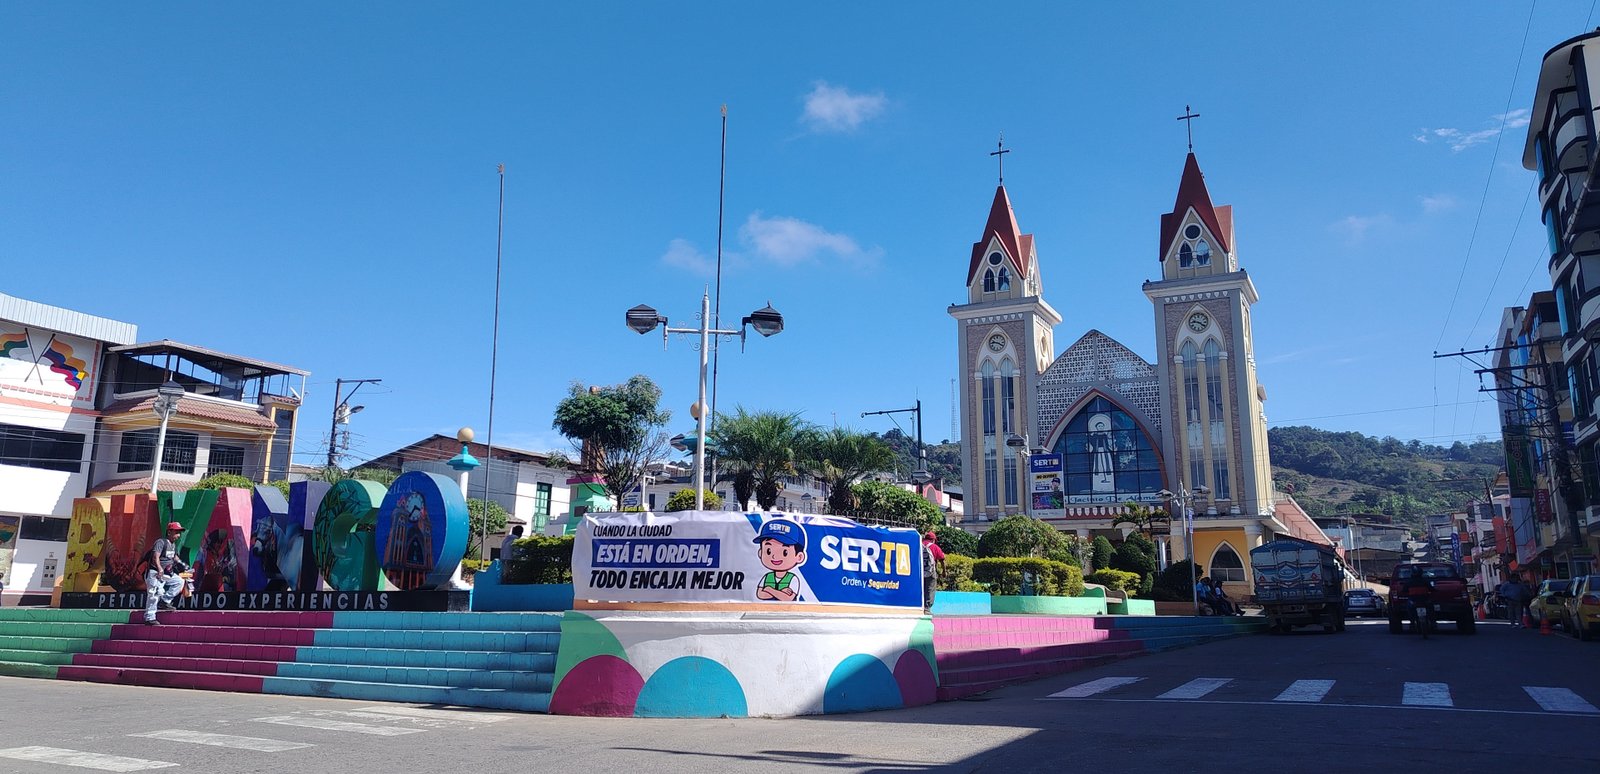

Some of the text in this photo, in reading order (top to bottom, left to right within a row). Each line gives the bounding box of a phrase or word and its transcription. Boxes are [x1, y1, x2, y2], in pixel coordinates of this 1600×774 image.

[62, 471, 469, 593] PUYANGO
[593, 525, 672, 537] CUANDO LA CIUDAD
[596, 541, 713, 567] ESTÁ EN ORDEN,
[820, 534, 911, 576] SERTA
[589, 570, 745, 590] TODO ENCAJA MEJOR
[841, 576, 900, 590] Orden y Seguridad
[98, 593, 389, 610] PETRIANDO EXPERIENCIAS
